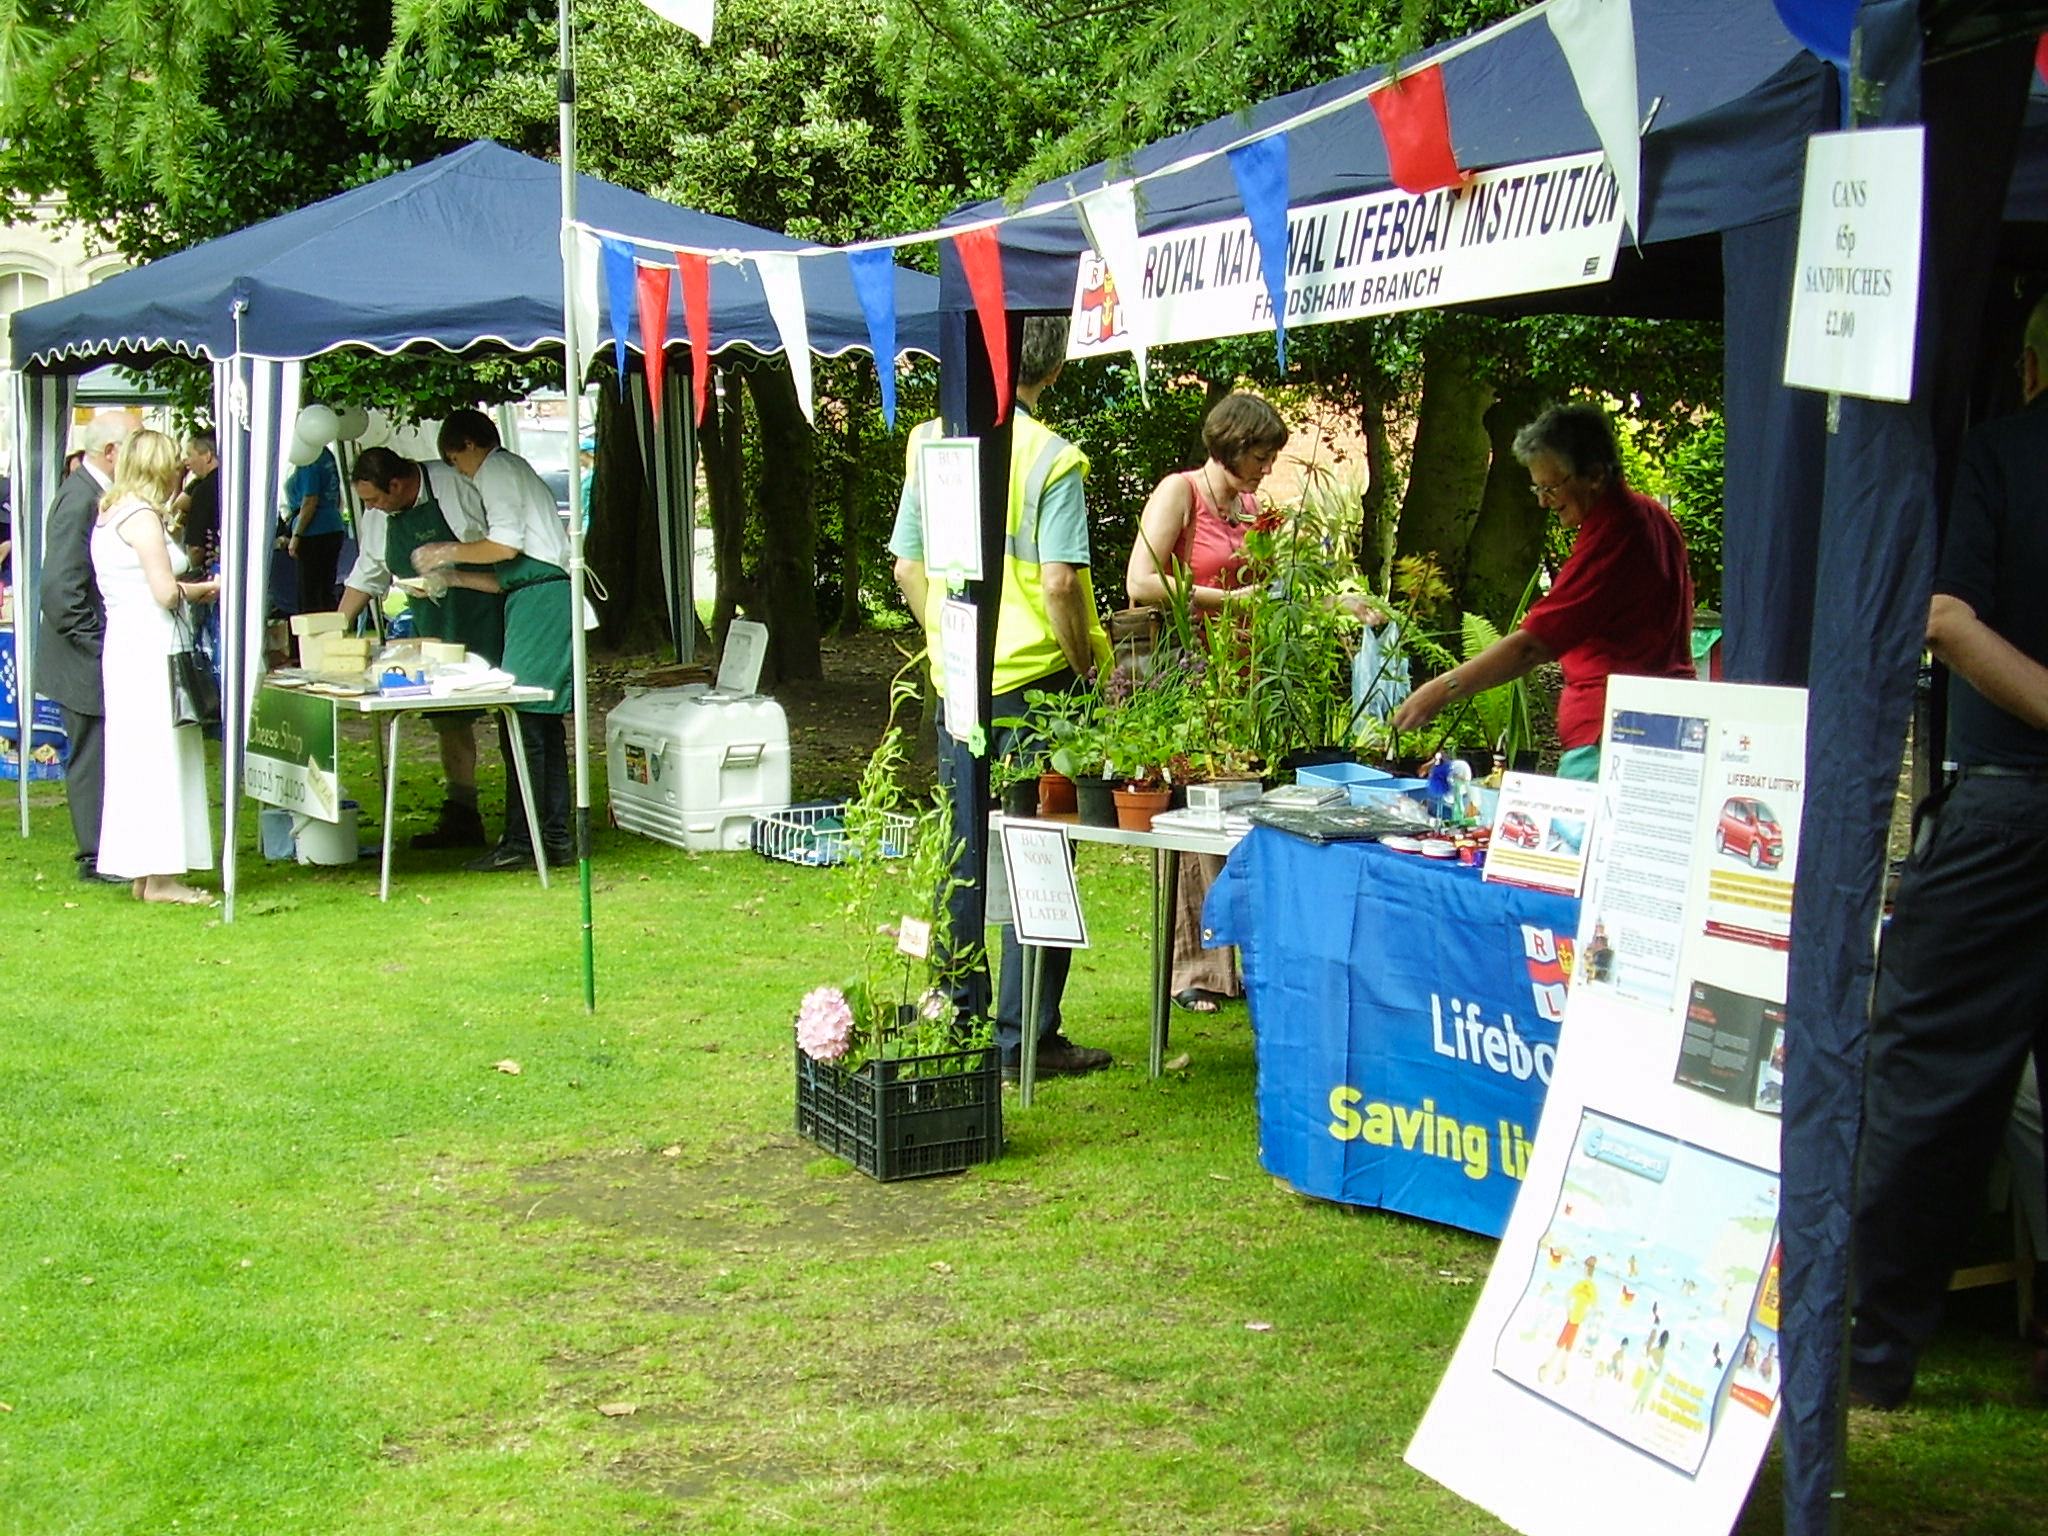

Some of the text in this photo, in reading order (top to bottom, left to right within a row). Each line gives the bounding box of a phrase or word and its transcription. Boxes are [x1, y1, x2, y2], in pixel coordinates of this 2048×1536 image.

[1832, 179, 1867, 208] CANS
[1142, 162, 1621, 300] ROYAL NATNAL LIFEBOAT INSTITUTION
[1252, 265, 1444, 321] FRDSHAM BRANCH
[1805, 265, 1893, 298] SANDWICHES
[1825, 310, 1856, 339] £2.00
[280, 720, 304, 761] Shop
[1727, 773, 1767, 789] LIFEBOAT
[1021, 833, 1047, 847] BUY
[1023, 852, 1053, 865] NOW
[1018, 888, 1071, 904] COLLECT
[1028, 906, 1069, 921] LATER
[1327, 1085, 1489, 1180] Saving
